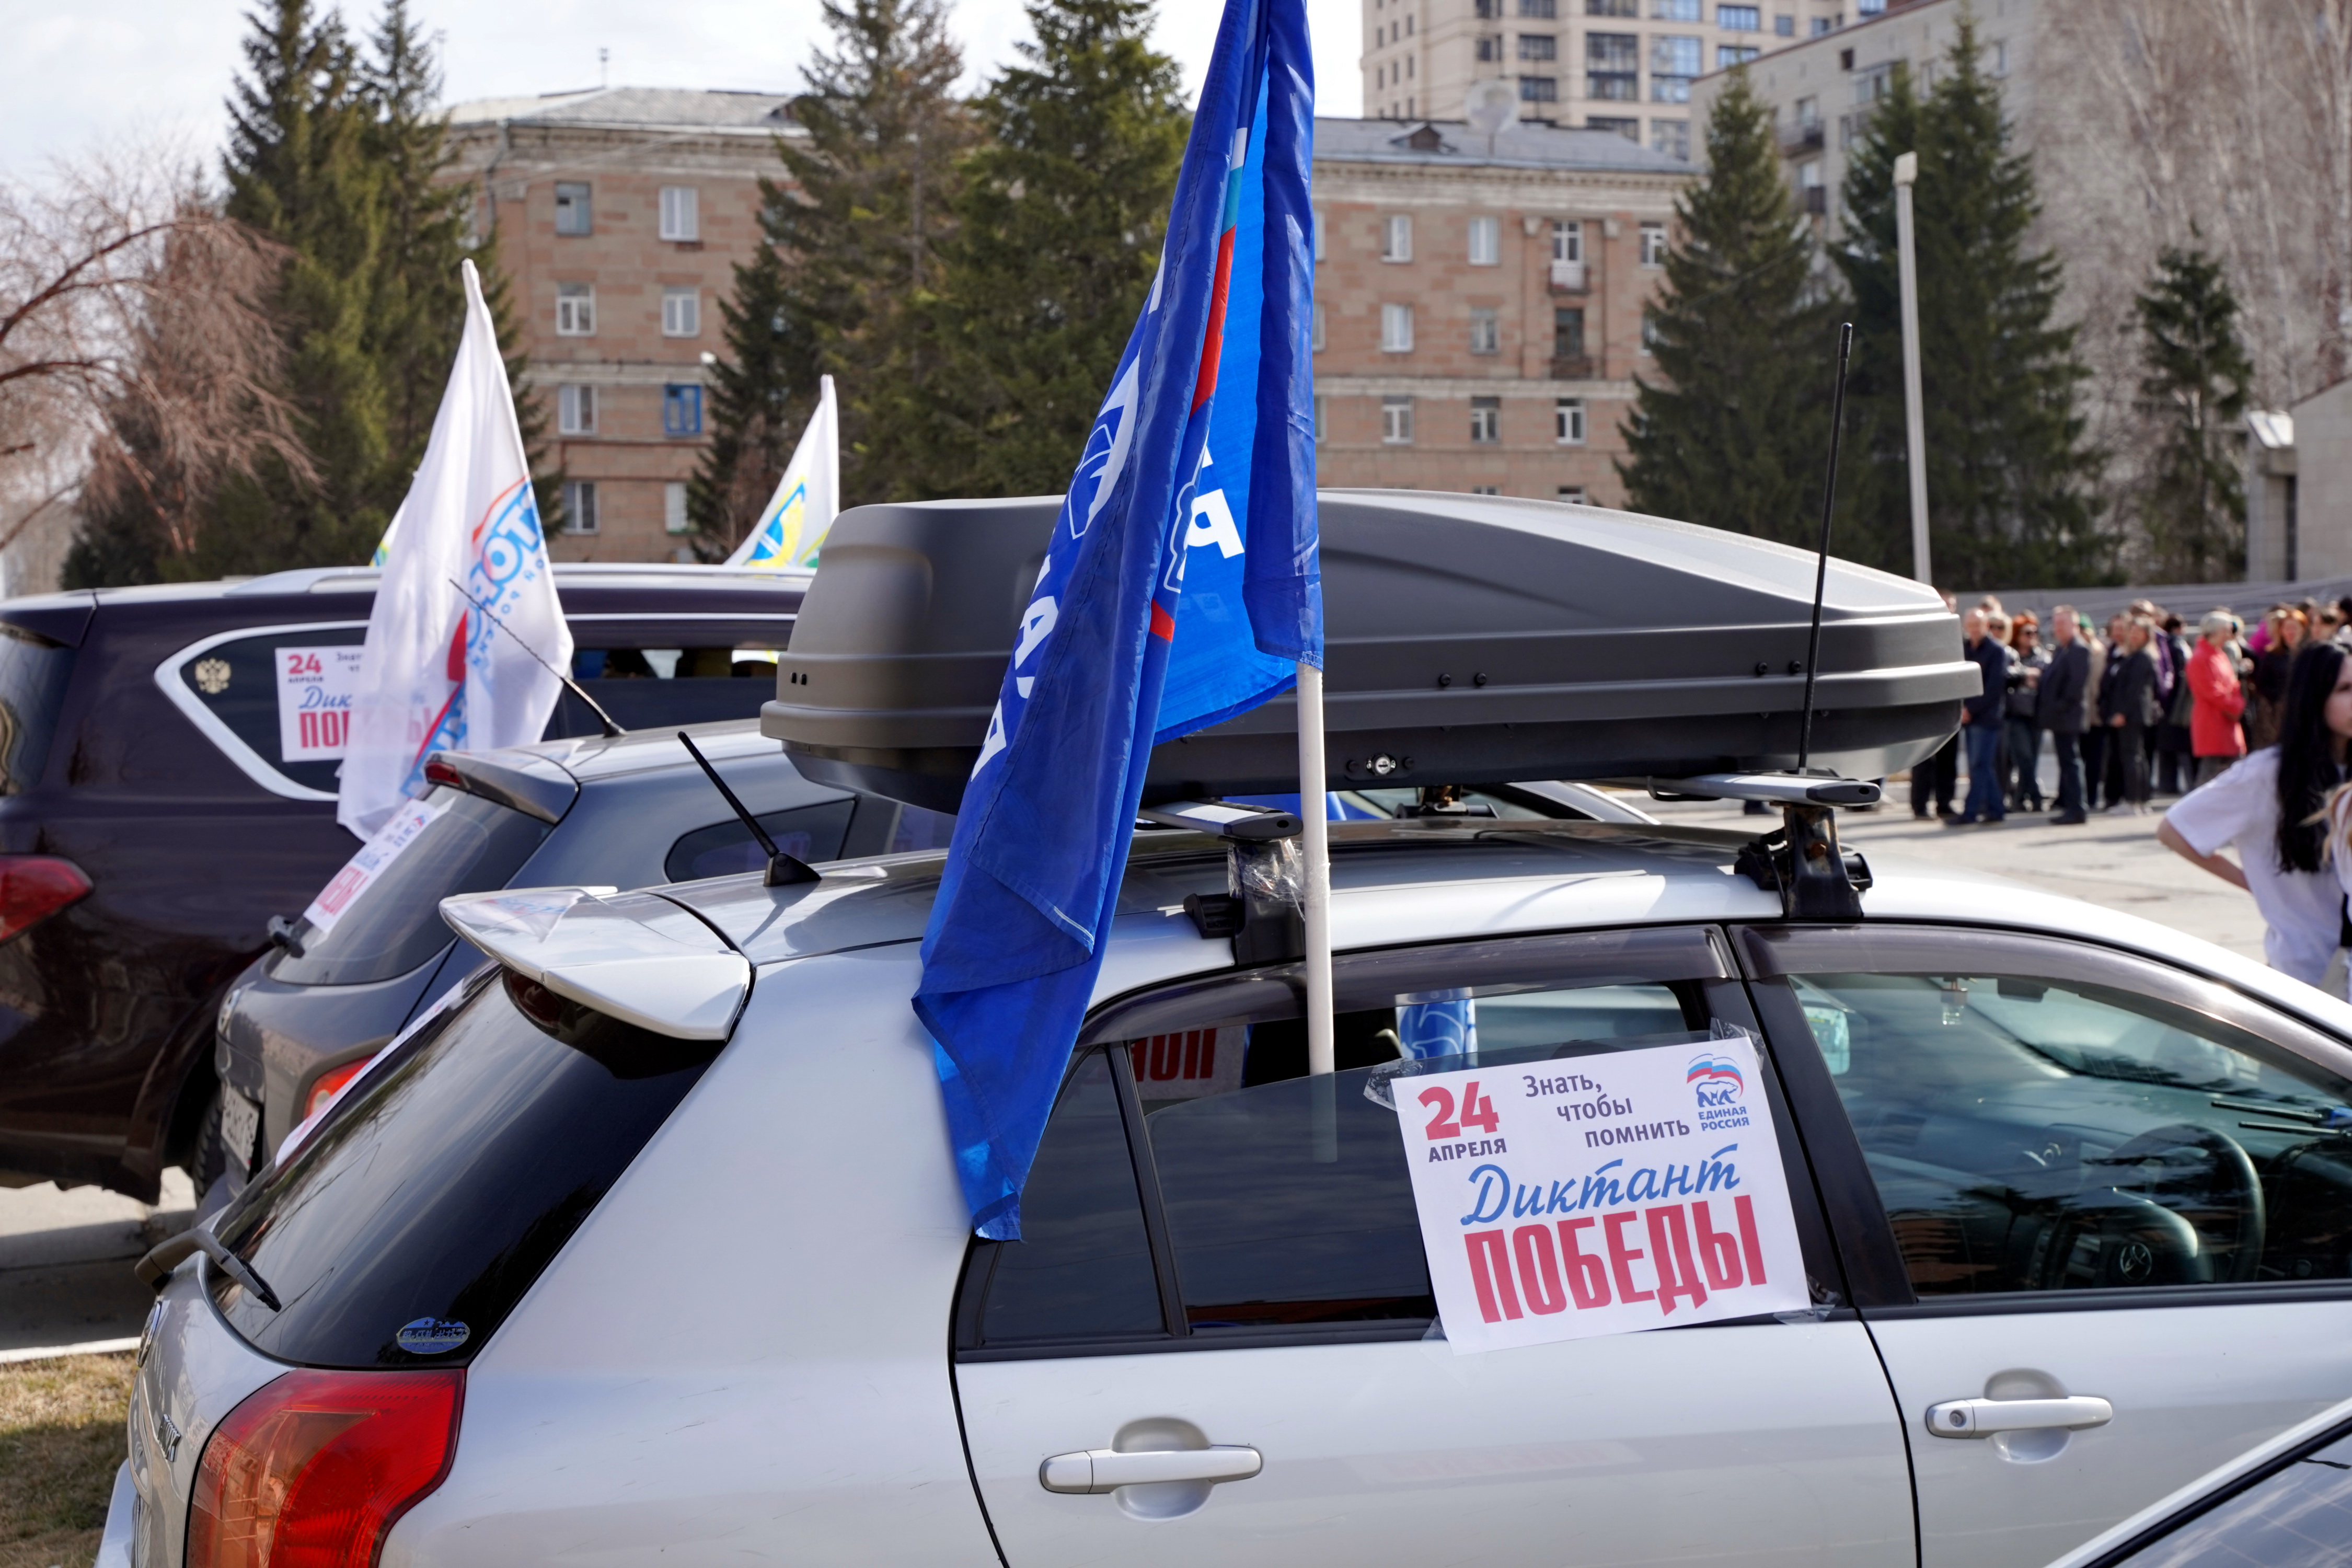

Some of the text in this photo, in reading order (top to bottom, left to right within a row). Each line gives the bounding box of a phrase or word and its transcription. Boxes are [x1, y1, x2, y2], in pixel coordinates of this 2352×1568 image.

[288, 653, 322, 674] 24
[1523, 1074, 1601, 1097] Знать,
[1417, 1081, 1500, 1140] 24
[1557, 1093, 1633, 1122] чтобы
[1698, 1106, 1747, 1120] ЕДИНАЯ
[1585, 1120, 1690, 1148] помнить
[1701, 1117, 1750, 1131] РОССИЯ
[1428, 1138, 1507, 1163] АПРЕЛЯ
[1460, 1143, 1740, 1226] Диктант
[1463, 1194, 1767, 1324] ПОБЕДЫ
